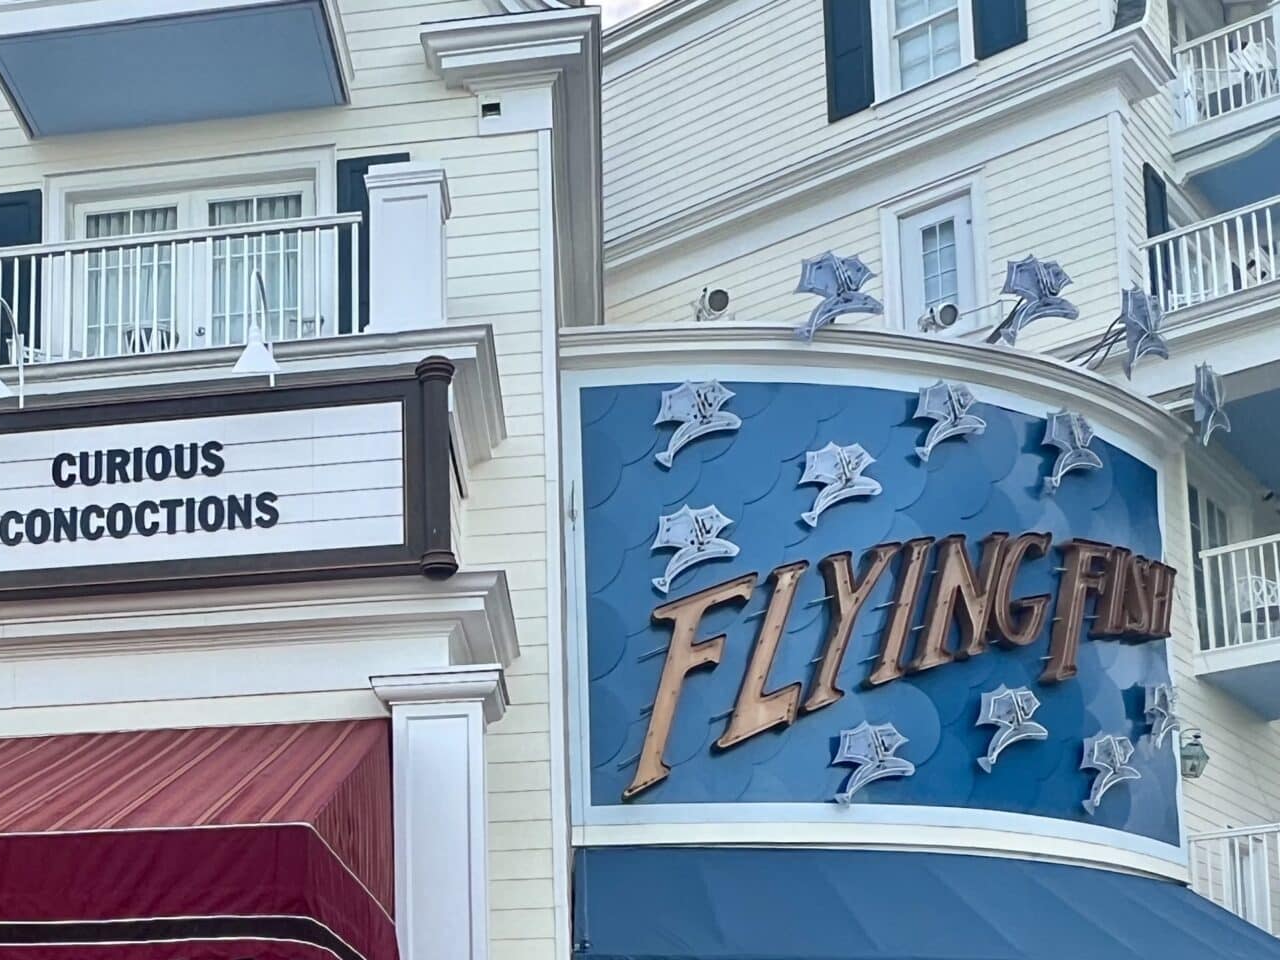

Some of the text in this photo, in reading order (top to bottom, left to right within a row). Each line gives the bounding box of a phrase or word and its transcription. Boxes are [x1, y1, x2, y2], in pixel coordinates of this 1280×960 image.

[51, 440, 225, 488] CURIOUS
[621, 531, 1176, 802] FLYING FISH
